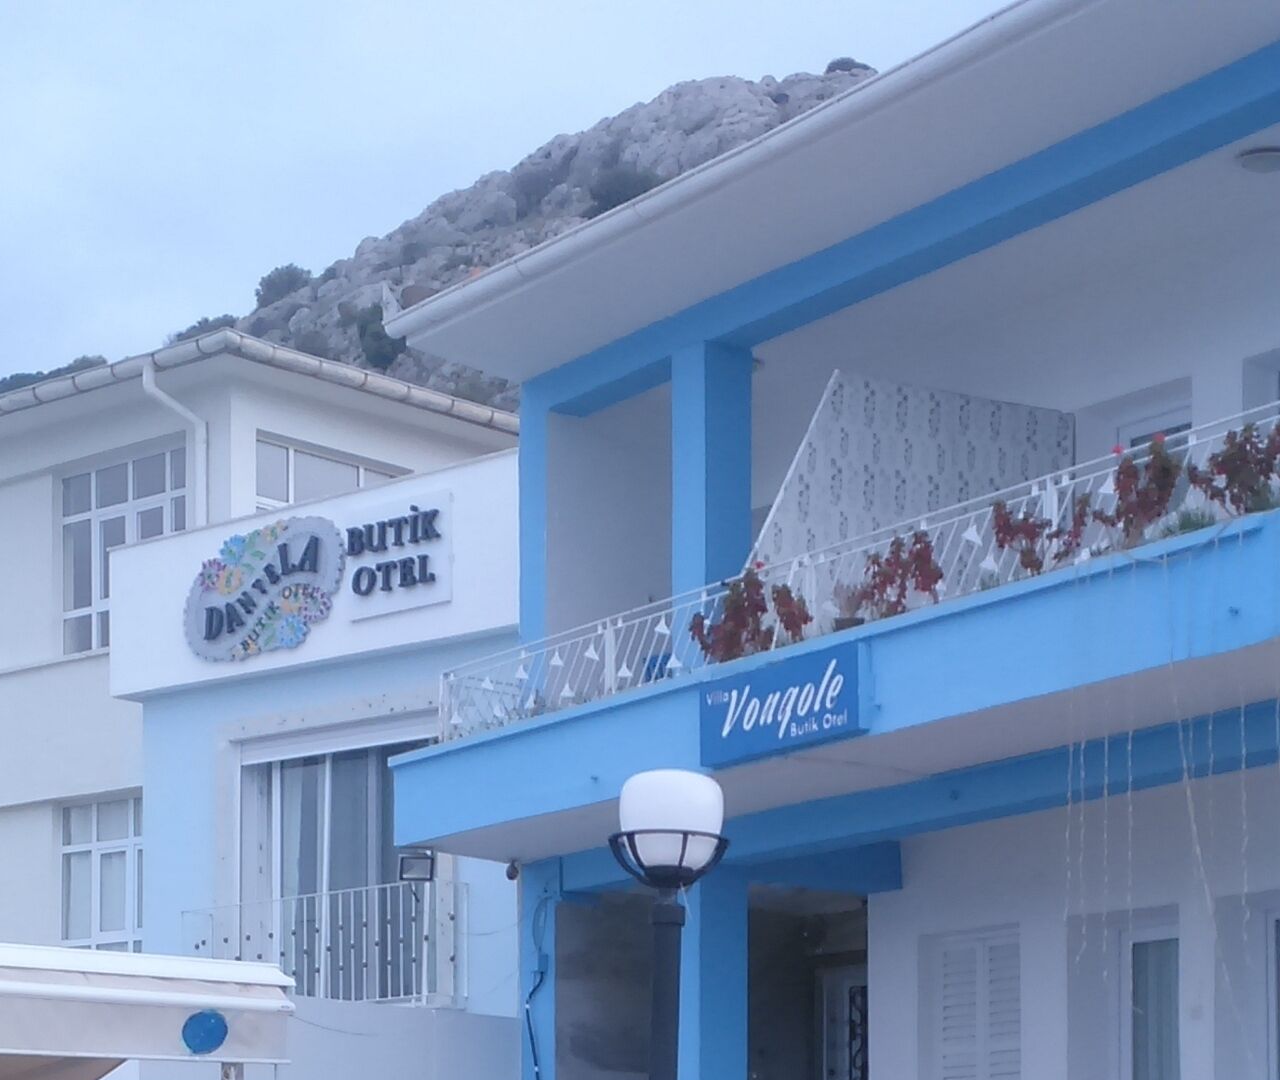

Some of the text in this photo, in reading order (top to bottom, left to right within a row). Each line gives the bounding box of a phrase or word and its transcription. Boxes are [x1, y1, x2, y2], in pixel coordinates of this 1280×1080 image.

[351, 554, 436, 597] OTEL
[722, 658, 844, 740] Vongole
[790, 709, 848, 737] Butik Otel
